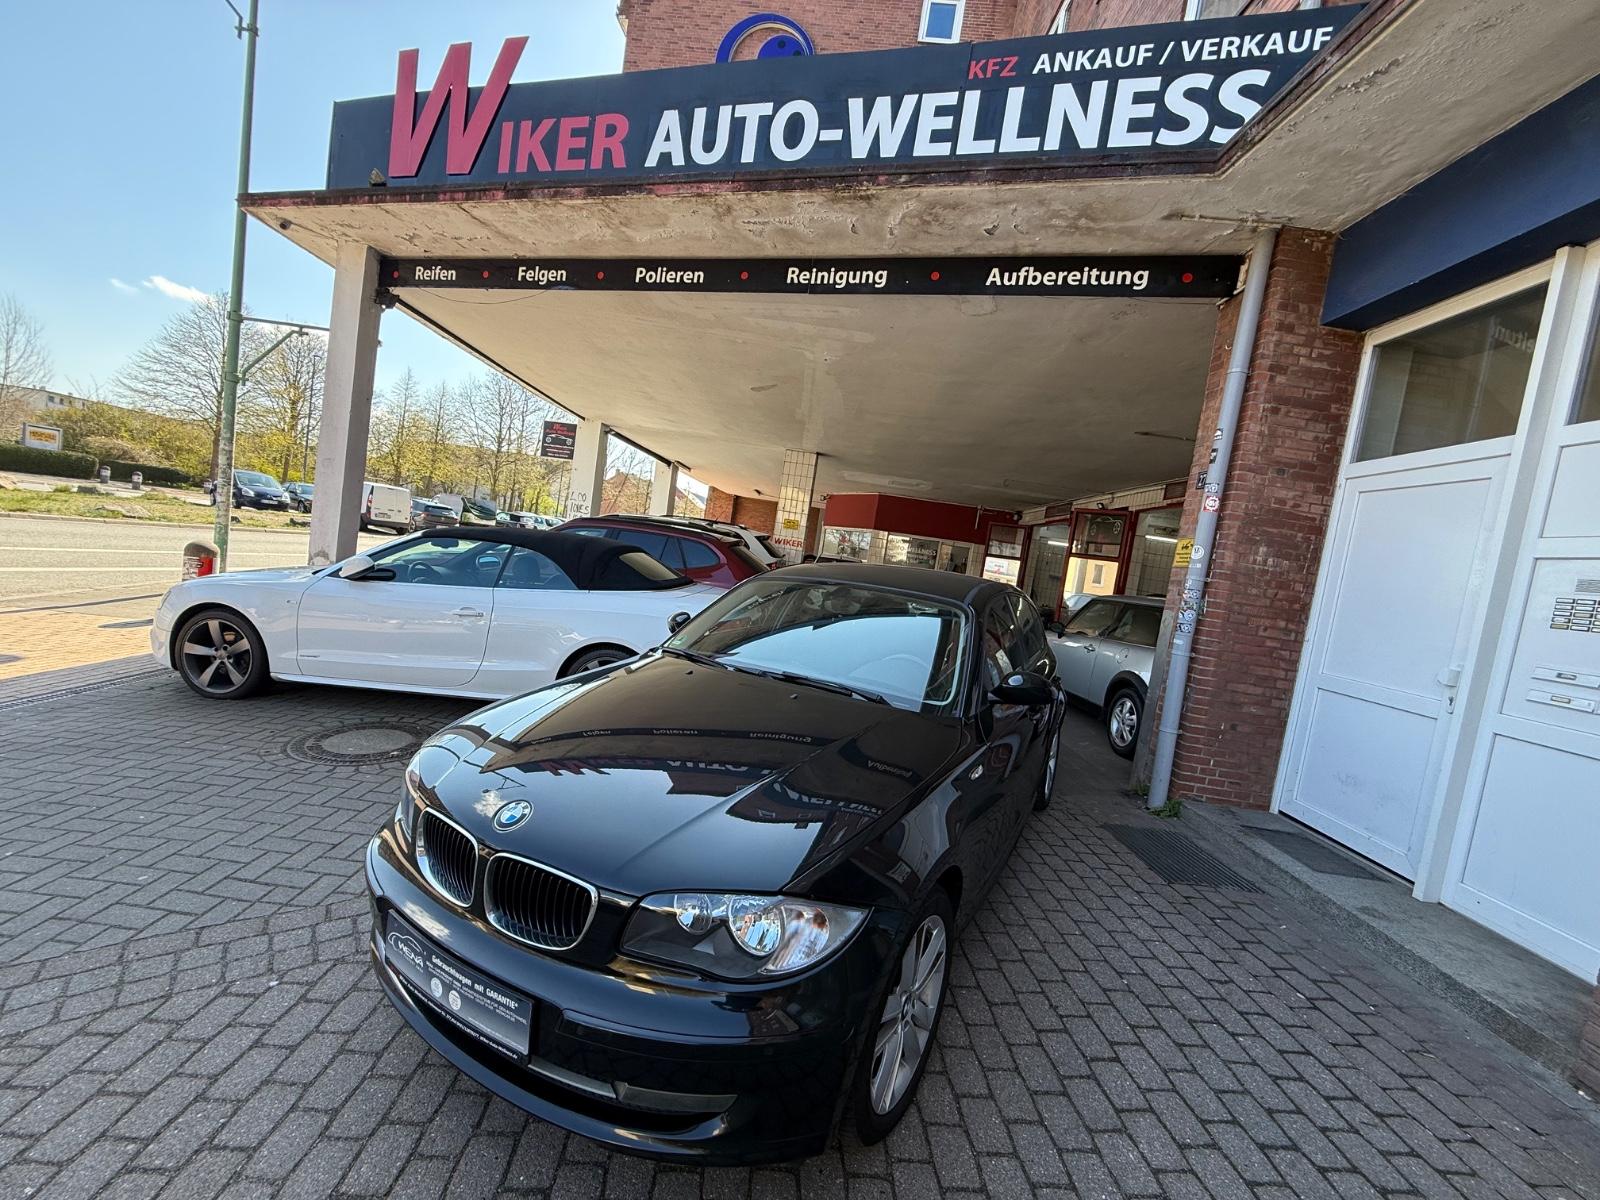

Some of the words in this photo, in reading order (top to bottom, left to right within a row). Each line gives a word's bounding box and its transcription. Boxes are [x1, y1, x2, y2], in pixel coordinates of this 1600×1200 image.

[968, 56, 1019, 80] KFZ
[1032, 43, 1156, 76] ANKAUF
[1159, 41, 1175, 66] /
[1180, 26, 1335, 63] VERKAUF
[387, 36, 630, 178] WIKER
[644, 69, 1273, 168] AUTO-WELLNESS
[415, 266, 457, 283] Reifen
[517, 266, 568, 284] Felgen
[635, 266, 705, 286] Polieren
[786, 266, 888, 291] Reinigung
[985, 266, 1150, 292] Aufbereitung
[774, 537, 803, 549] WIKER
[474, 983, 485, 993] mit
